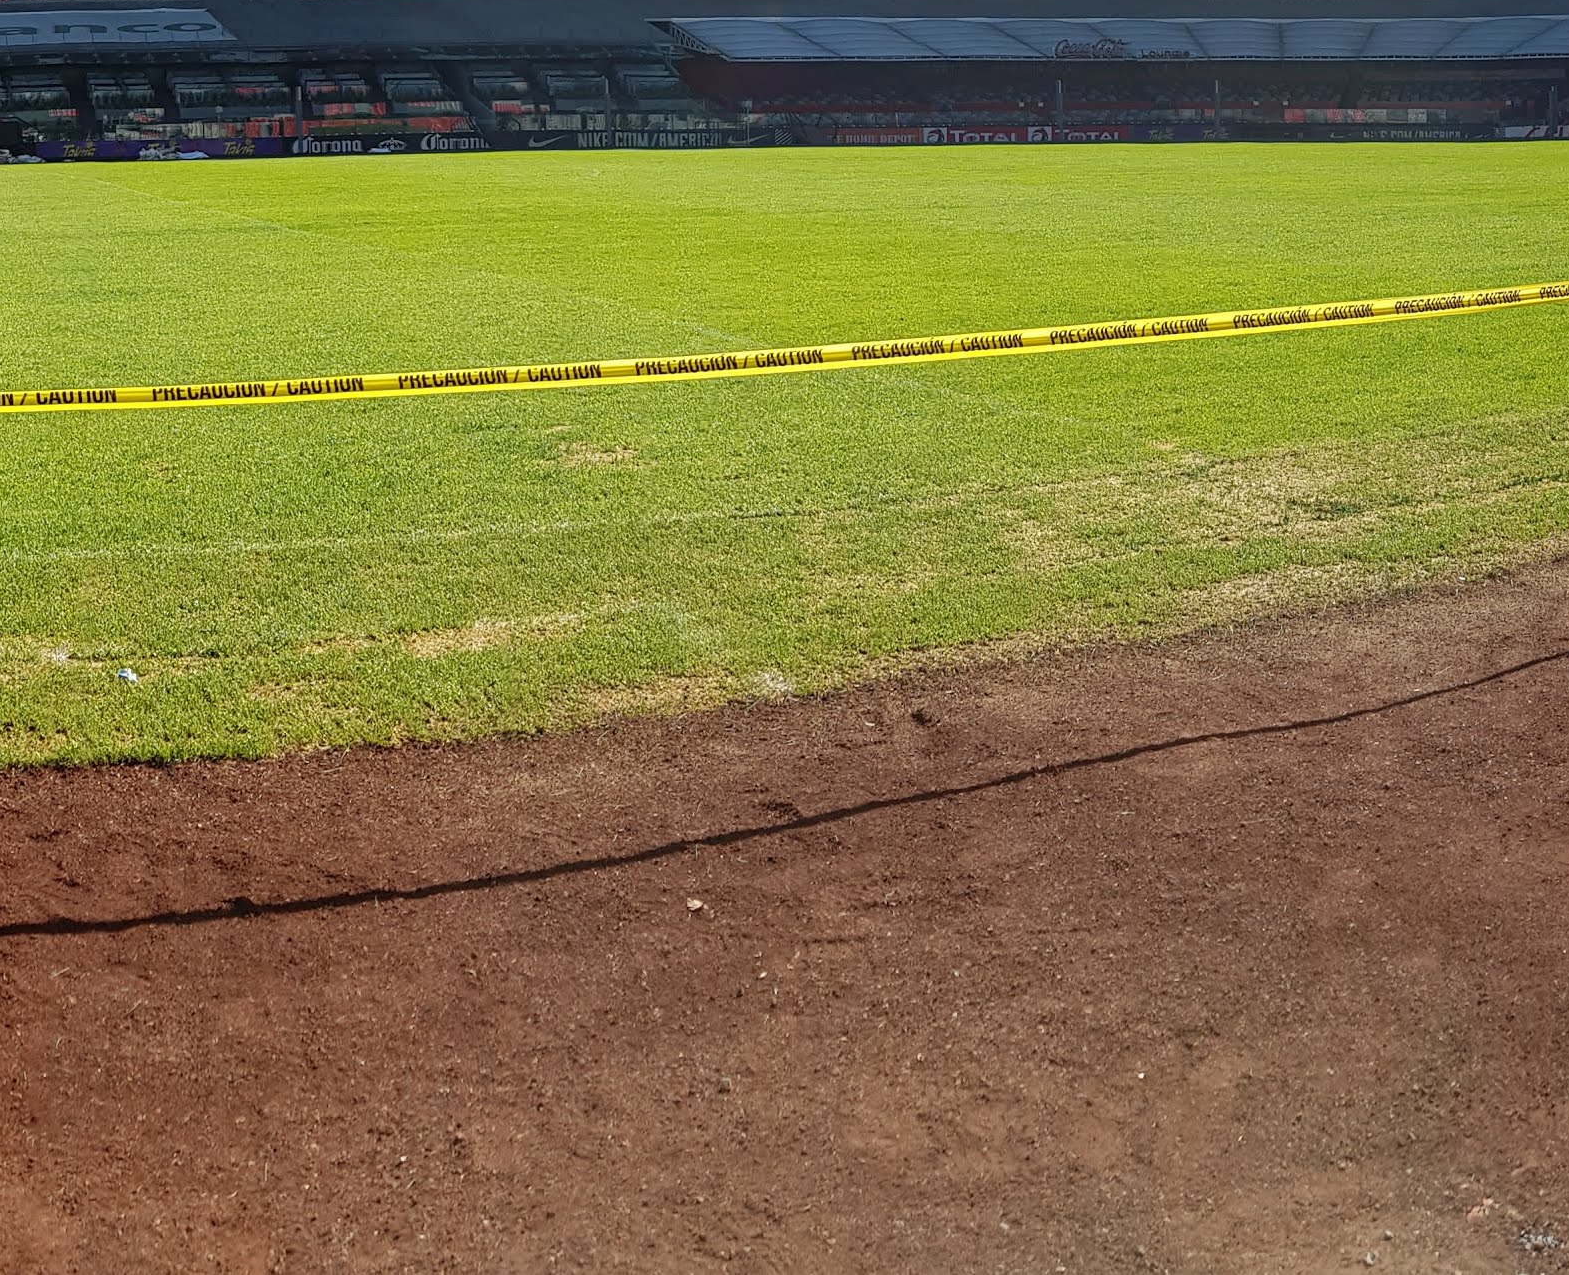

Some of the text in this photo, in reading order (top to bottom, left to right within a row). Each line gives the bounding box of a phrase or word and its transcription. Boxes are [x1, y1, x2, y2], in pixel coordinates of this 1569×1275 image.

[292, 136, 362, 153] Corona
[1474, 289, 1521, 307] CAUTION
[1322, 303, 1374, 321] CAUTION
[1151, 317, 1209, 336] CAUTION
[960, 333, 1024, 352] CAUTION
[754, 348, 824, 368] CAUTION
[527, 364, 602, 382] CAUTION
[286, 377, 364, 396] CAUTION
[35, 389, 117, 406] CAUTION
